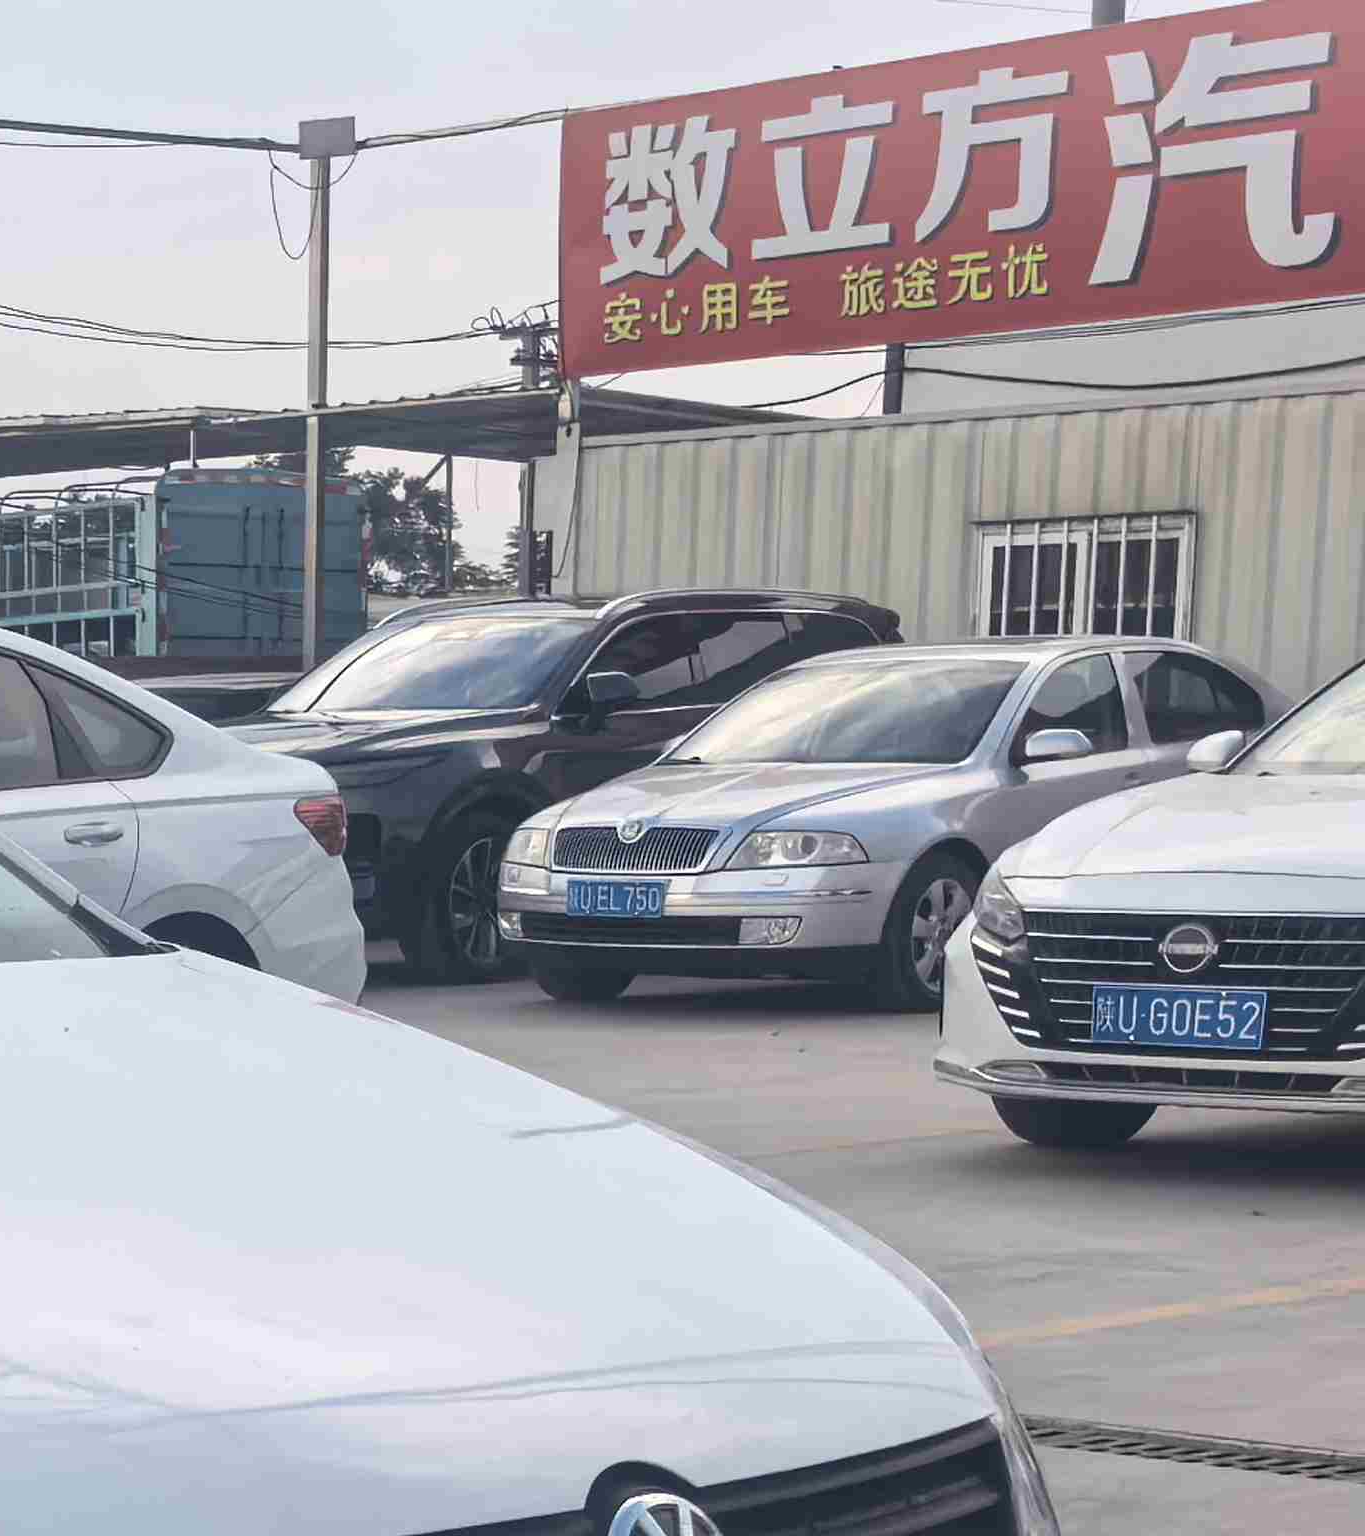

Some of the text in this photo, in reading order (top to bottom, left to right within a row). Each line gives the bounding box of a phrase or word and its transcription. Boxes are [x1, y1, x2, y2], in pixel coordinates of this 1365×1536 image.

[600, 31, 1336, 286] 数立方汽
[603, 242, 1051, 345] 安心用车 旅途无忧
